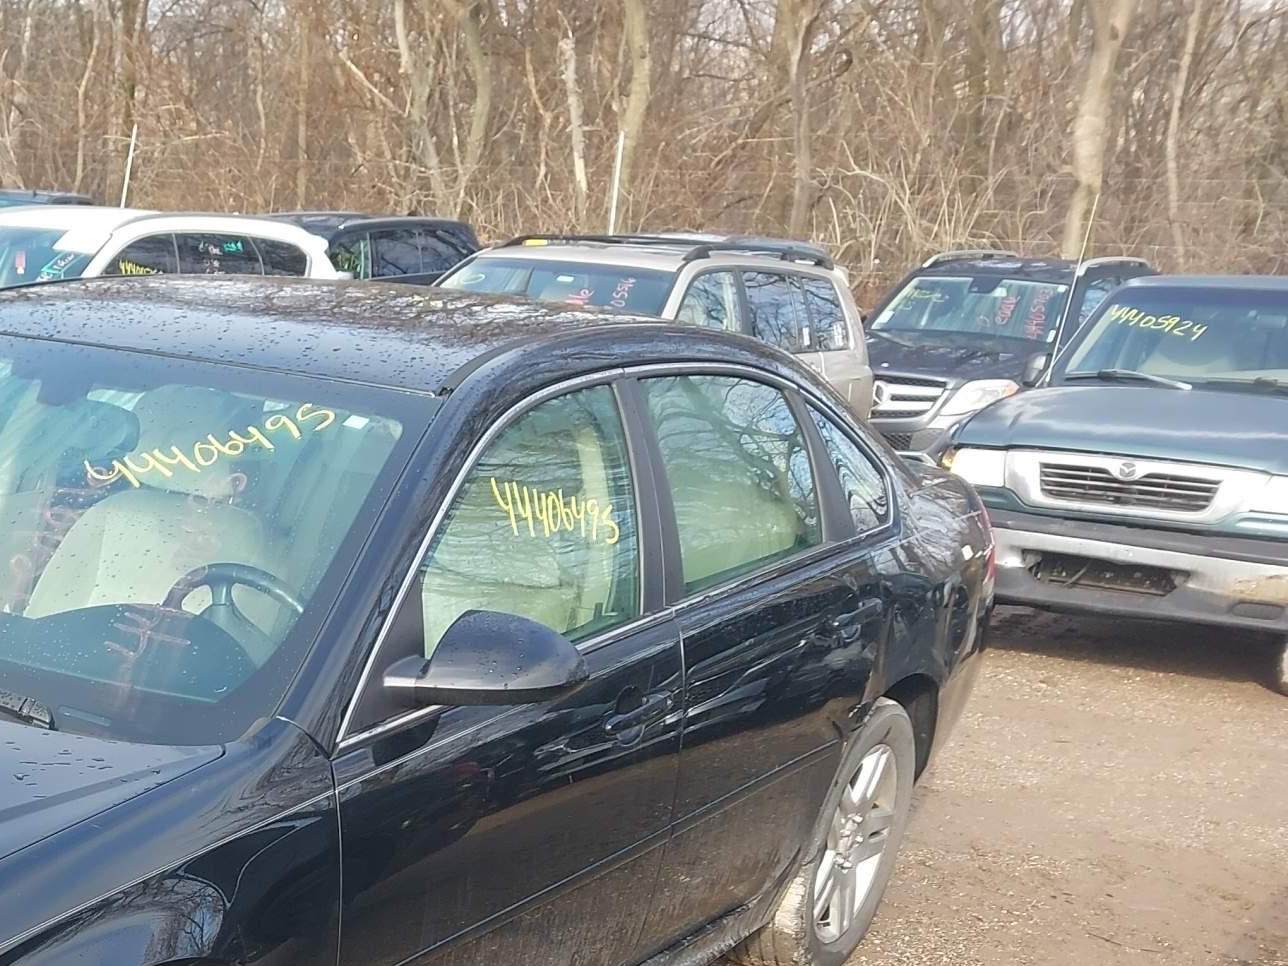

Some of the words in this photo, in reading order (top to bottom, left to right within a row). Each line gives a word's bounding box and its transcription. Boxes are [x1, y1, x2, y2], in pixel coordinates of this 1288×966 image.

[1111, 303, 1209, 341] 44405924
[83, 402, 337, 488] 44406495
[491, 476, 621, 545] 44406495
